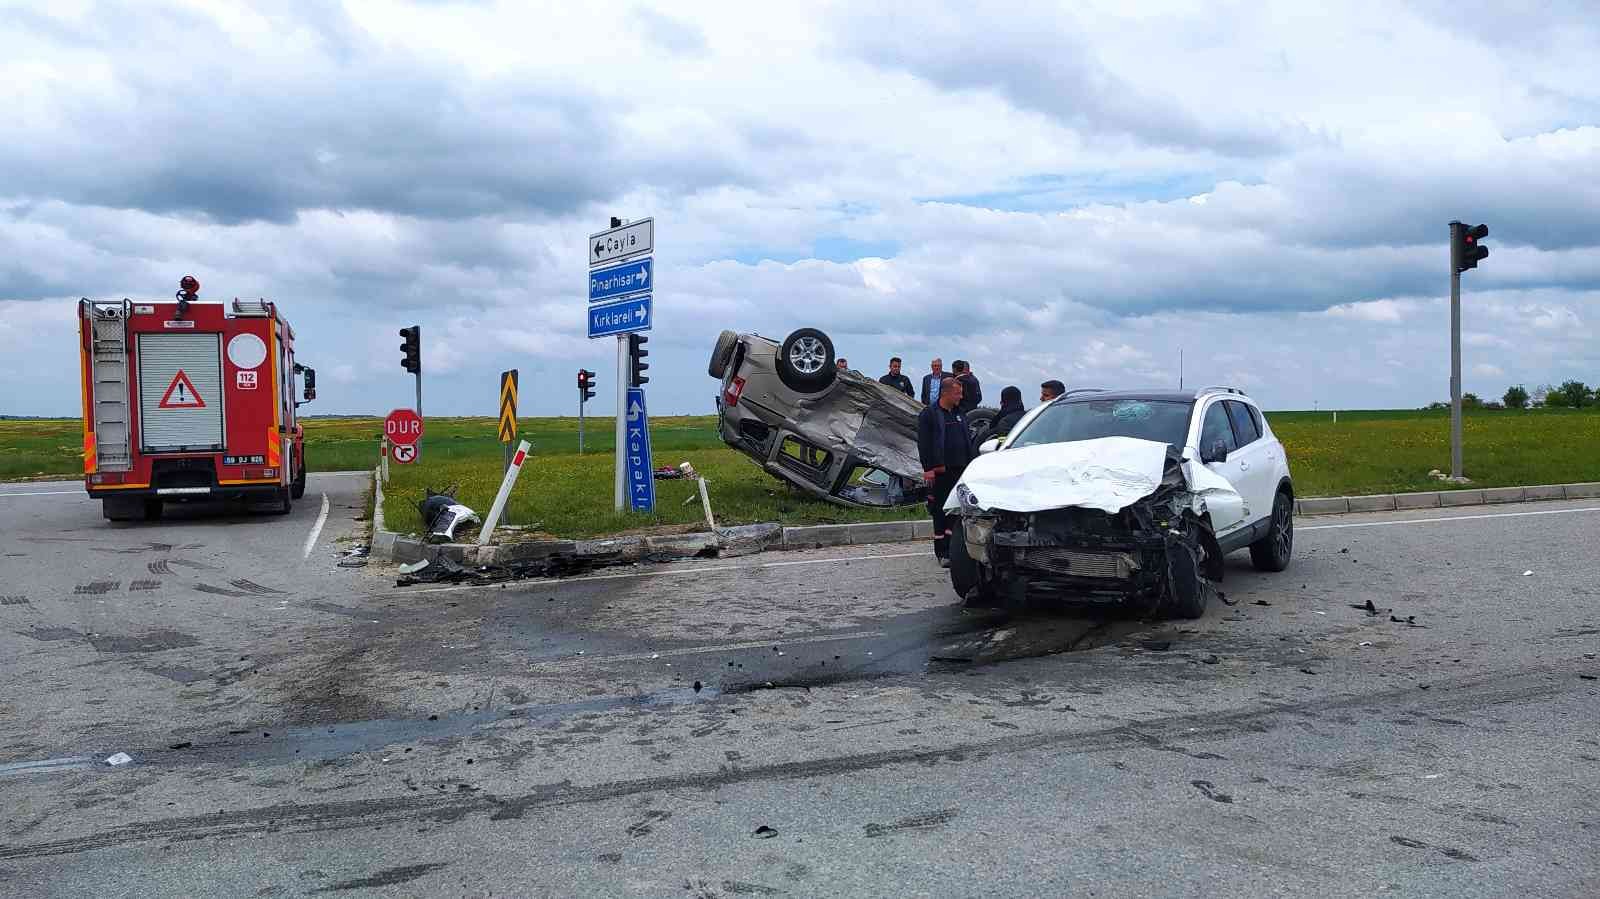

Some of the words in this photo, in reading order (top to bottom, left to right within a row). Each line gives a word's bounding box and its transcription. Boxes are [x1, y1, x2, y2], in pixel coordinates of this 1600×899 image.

[606, 231, 636, 254] Çayla
[240, 373, 255, 382] 112
[387, 421, 420, 434] DUR
